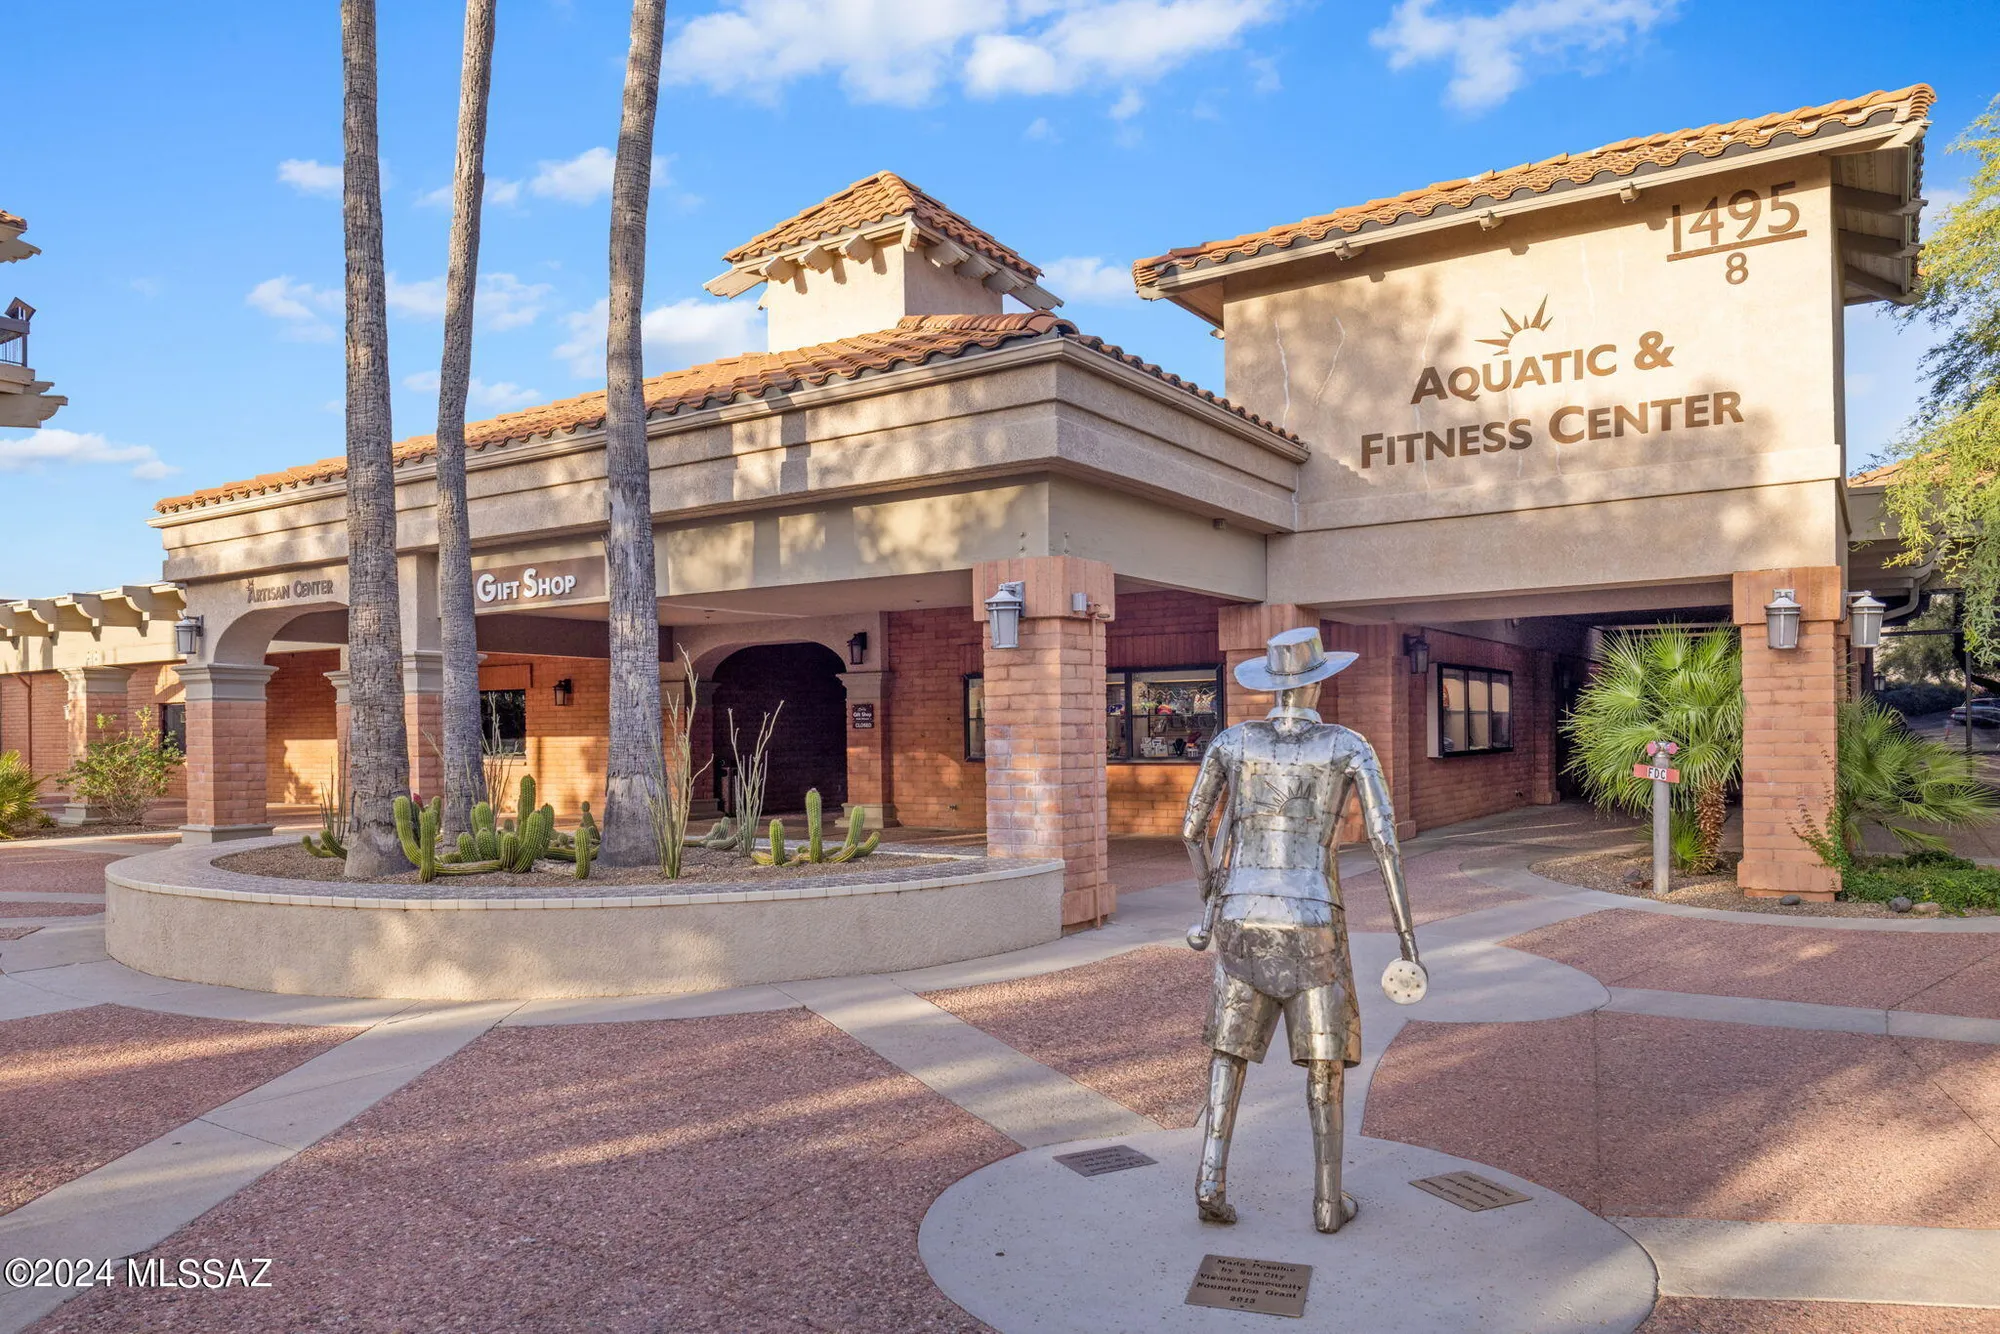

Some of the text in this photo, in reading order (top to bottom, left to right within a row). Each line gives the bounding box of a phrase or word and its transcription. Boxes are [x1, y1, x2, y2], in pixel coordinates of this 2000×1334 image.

[1672, 181, 1800, 252] 1495
[1725, 252, 1749, 285] 8
[1410, 330, 1675, 402] AQUATIC &
[1361, 391, 1744, 469] FITNESS CENTER
[247, 580, 334, 603] ARTISAN CENTER
[477, 567, 577, 603] GIFT SHOP
[1648, 767, 1665, 779] FDC
[1217, 1259, 1246, 1268] Made
[1241, 1278, 1304, 1291] Community
[1263, 1272, 1285, 1280] City
[1196, 1282, 1297, 1299] Foundation Grant
